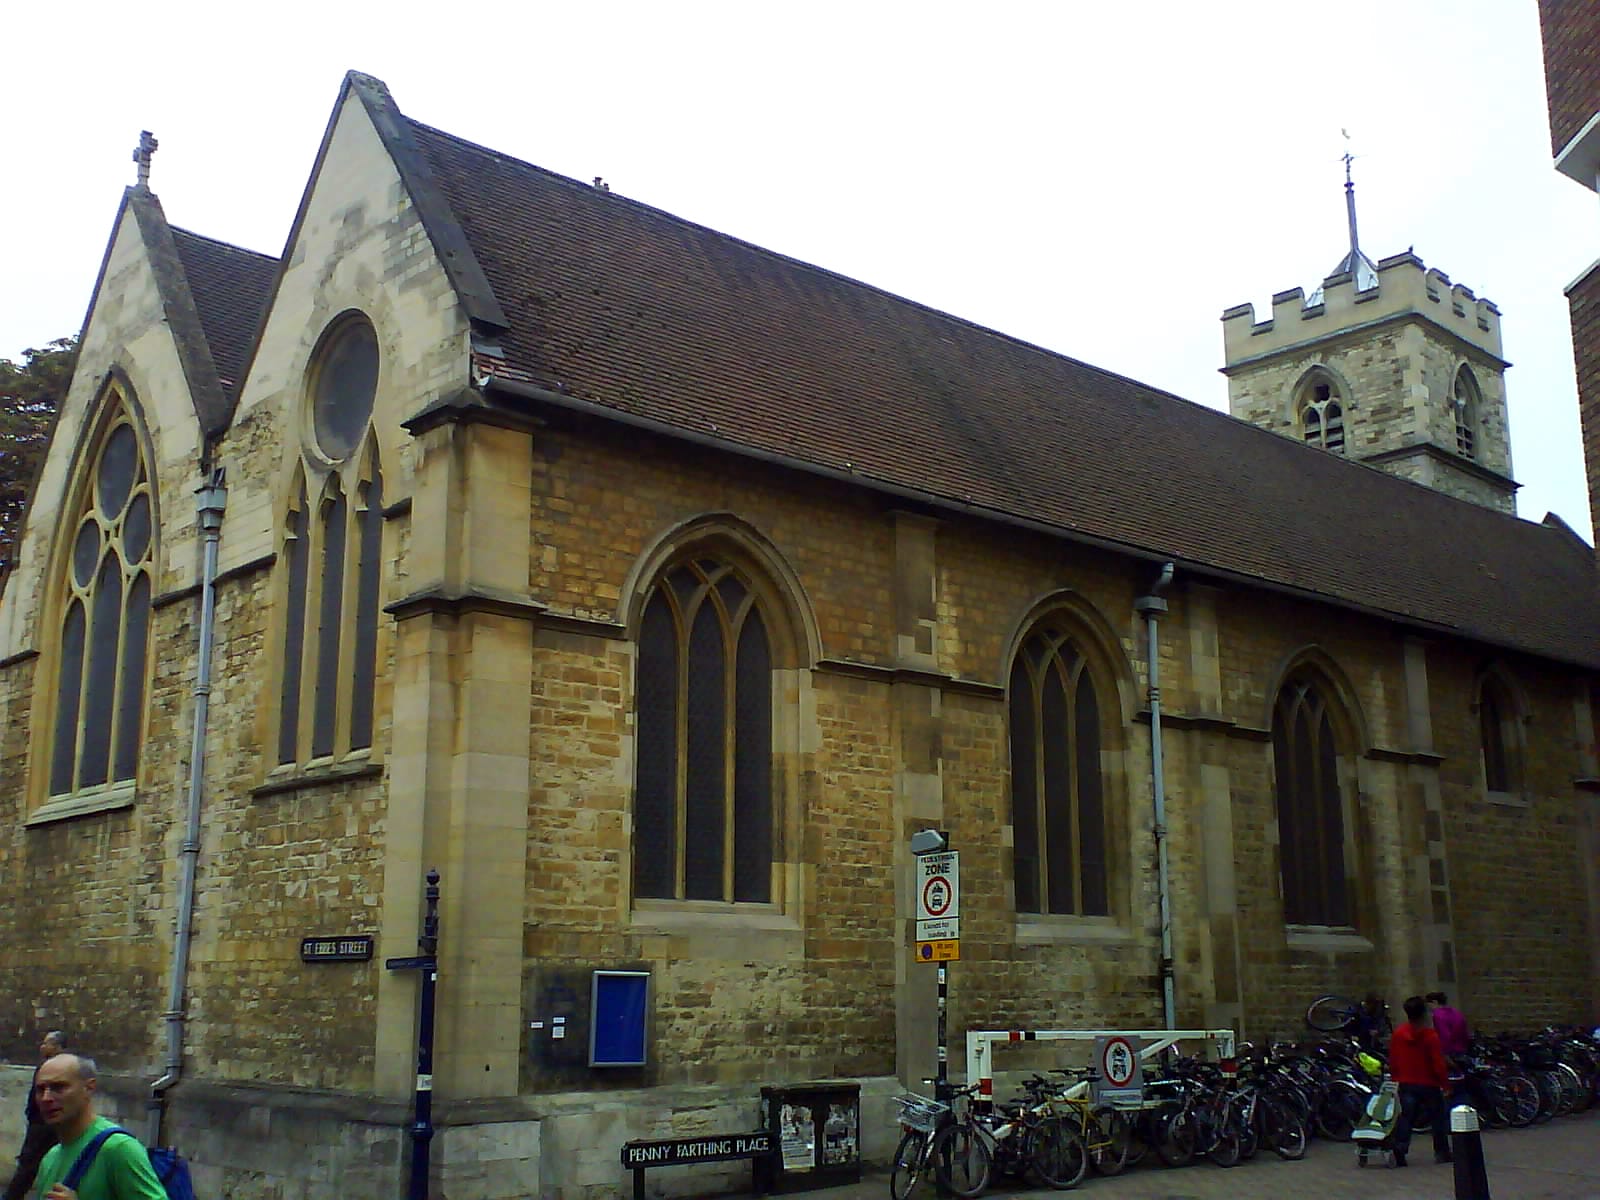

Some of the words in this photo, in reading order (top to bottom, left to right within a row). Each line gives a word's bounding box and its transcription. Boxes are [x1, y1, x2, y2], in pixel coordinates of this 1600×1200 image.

[925, 862, 950, 876] ZONE
[339, 940, 368, 954] STREET
[629, 1145, 671, 1162] PENNY
[676, 1140, 731, 1158] FARTHING
[736, 1137, 769, 1153] PLACE
